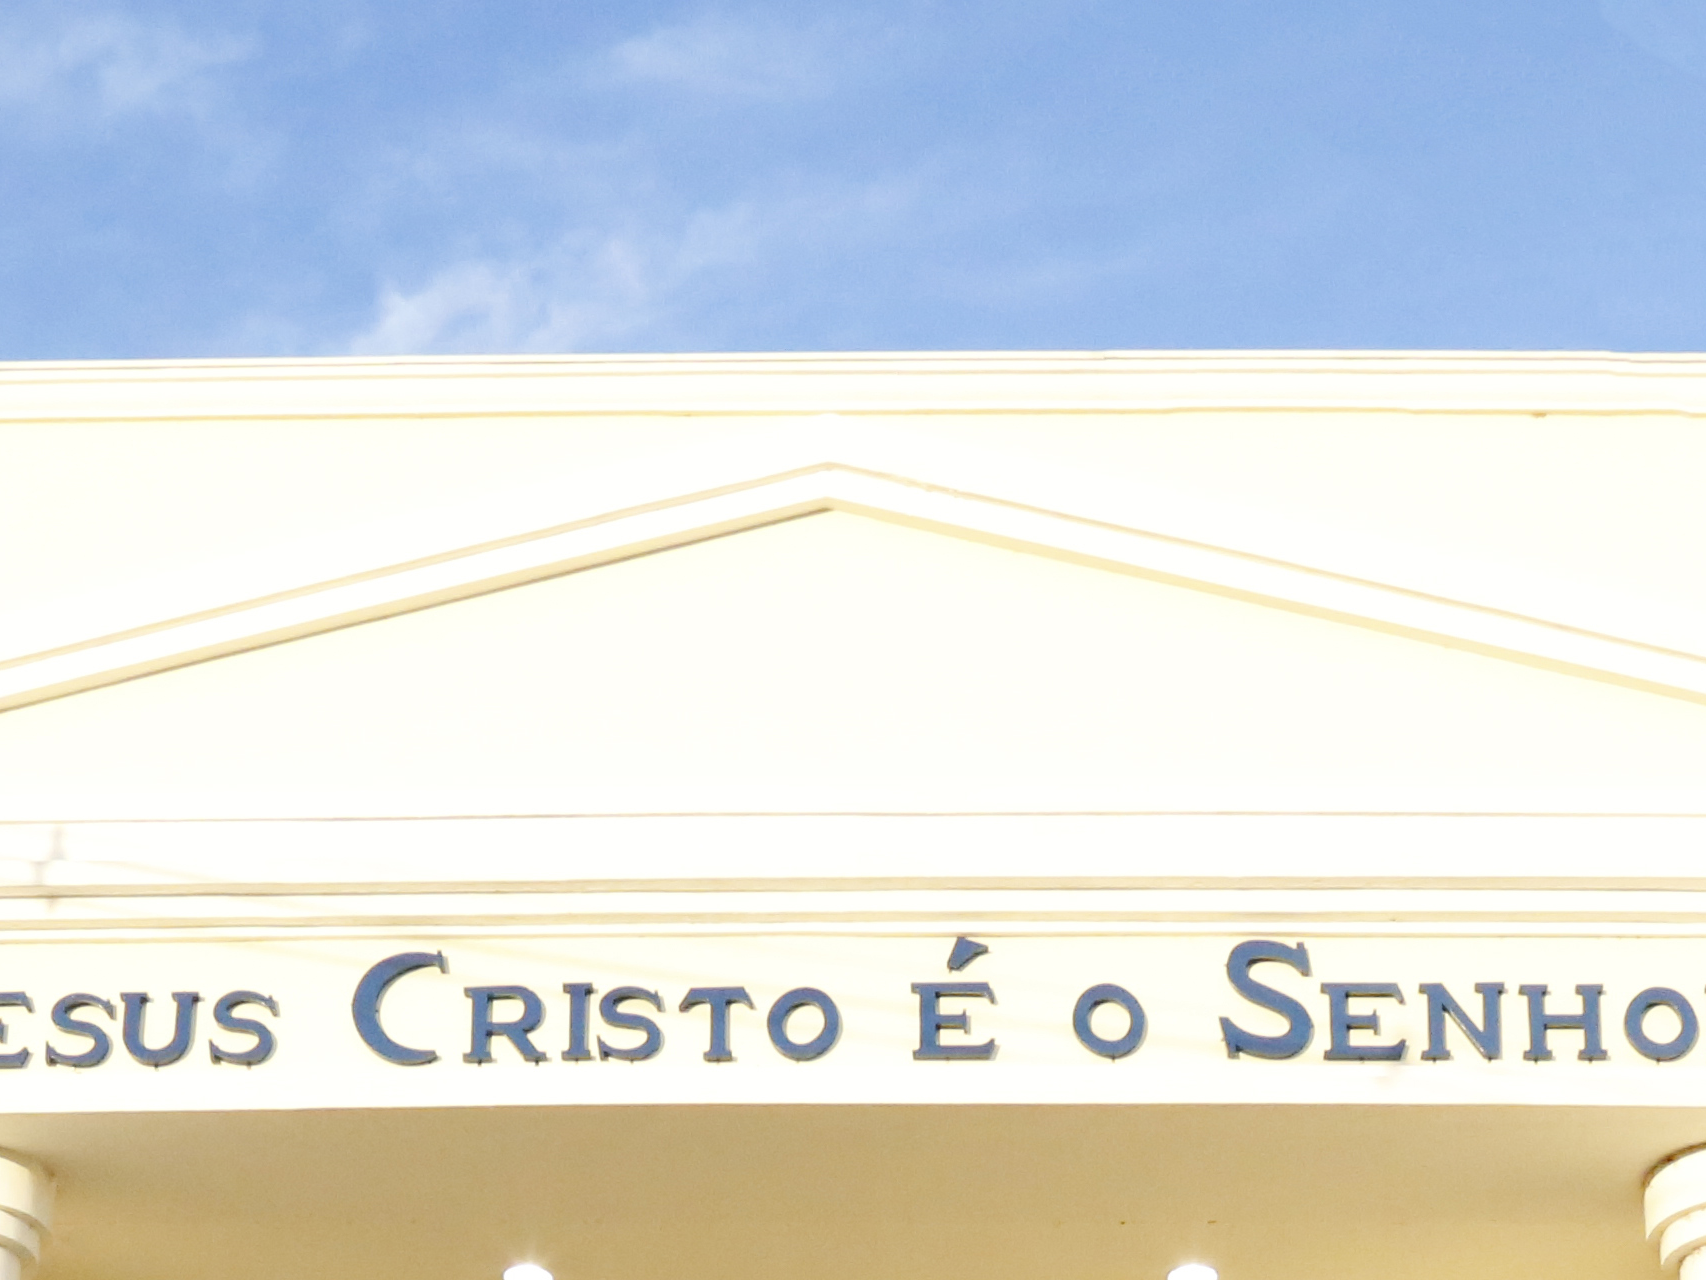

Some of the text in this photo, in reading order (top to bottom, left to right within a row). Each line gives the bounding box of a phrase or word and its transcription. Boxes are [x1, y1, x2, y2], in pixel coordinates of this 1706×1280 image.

[351, 950, 841, 1067] CRISTO
[910, 936, 996, 1062] É
[1072, 983, 1146, 1061] O
